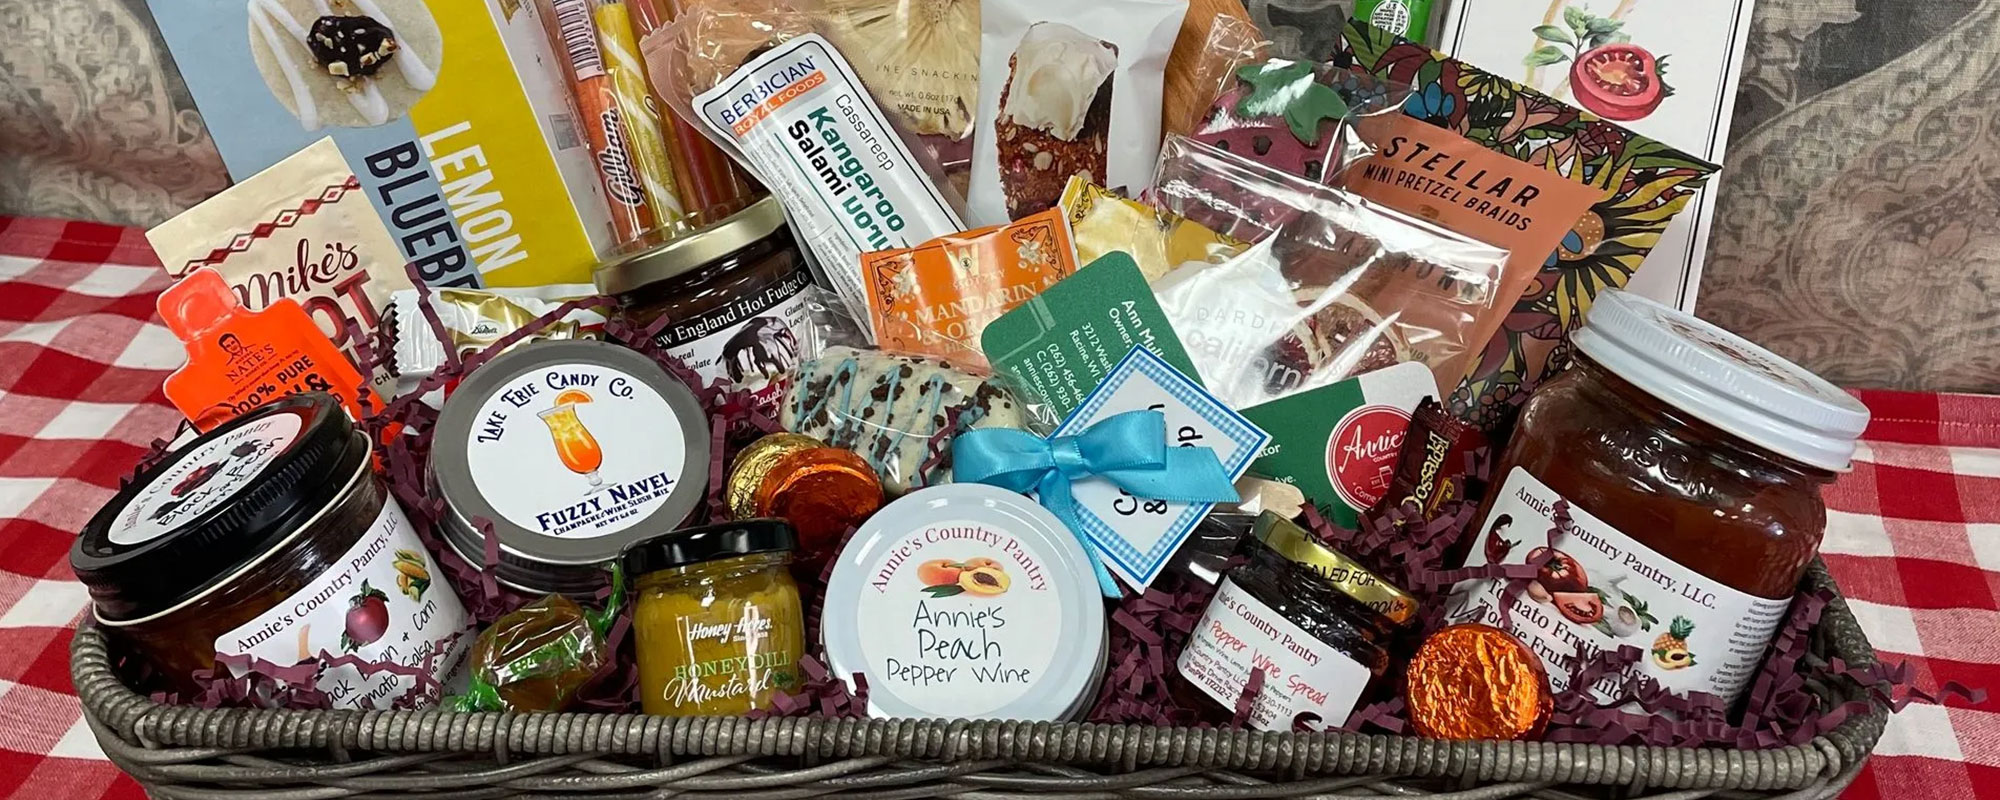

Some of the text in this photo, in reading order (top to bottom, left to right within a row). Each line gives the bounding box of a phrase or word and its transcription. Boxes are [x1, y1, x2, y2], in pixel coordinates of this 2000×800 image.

[720, 57, 816, 125] BERBICIAN
[911, 68, 977, 81] SNACKIN
[735, 75, 823, 134] ROYAL FOODS
[835, 93, 894, 171] Cassareep
[897, 103, 920, 112] MADE
[933, 107, 951, 115] USA
[788, 119, 852, 196] Salami
[807, 106, 905, 232] Kangaroo
[1383, 136, 1540, 207] STELLAR
[420, 120, 528, 275] LEMON
[1363, 163, 1531, 231] MINI PRETZEL BRAIDS
[231, 238, 359, 310] Mike's
[914, 281, 1038, 326] MANDARIN
[301, 269, 380, 348] OT
[675, 308, 737, 338] England
[738, 297, 766, 317] Hot
[765, 278, 798, 304] Fudge
[1082, 322, 1100, 347] 3212
[1121, 300, 1143, 329] Ann
[225, 343, 275, 382] NATE'S
[276, 355, 315, 385] PURE
[1040, 362, 1061, 387] (262)
[1046, 343, 1067, 368] (262)
[477, 372, 634, 443] LAKE ERIE CANDY CO.
[653, 487, 670, 498] MIX
[1415, 430, 1451, 500] Espresso
[536, 472, 675, 532] FUZZY NAVEL
[871, 525, 1048, 593] Annie's Country Pantry
[1515, 486, 1558, 523] Annies
[1622, 550, 1678, 593] Pantry,
[1680, 582, 1717, 609] LLC.
[237, 511, 399, 653] Annie's Country Pantry, LLC
[690, 622, 732, 644] Honey
[913, 600, 1006, 629] Annie's
[1236, 603, 1282, 642] Country
[1281, 633, 1322, 667] Pantry
[673, 650, 791, 681] HONEY DILL
[887, 658, 1031, 687] Pepper Wine
[918, 628, 1002, 661] Peach
[1209, 619, 1248, 653] Pepper
[1252, 648, 1283, 679] Wine
[1288, 672, 1329, 707] Spread
[1214, 660, 1232, 679] Pantry
[663, 669, 772, 708] Mustard
